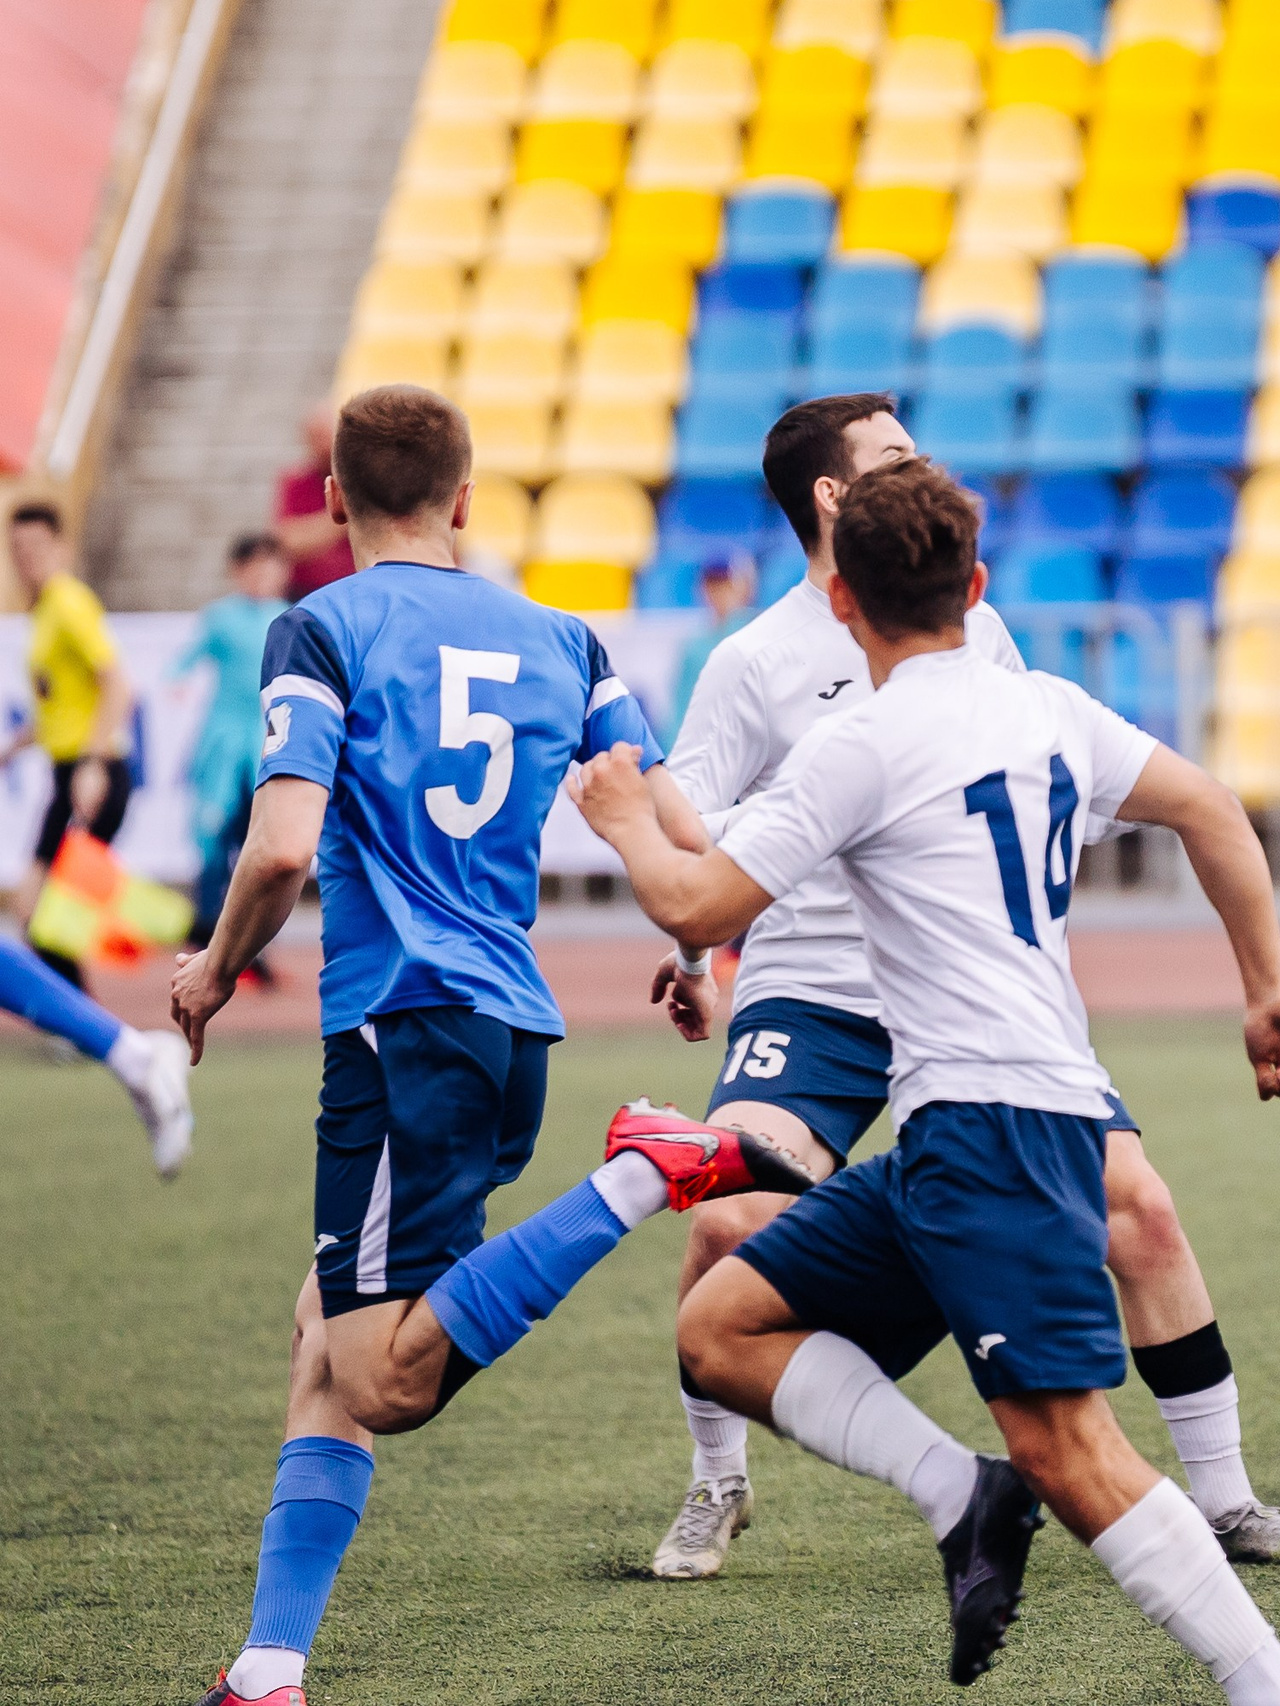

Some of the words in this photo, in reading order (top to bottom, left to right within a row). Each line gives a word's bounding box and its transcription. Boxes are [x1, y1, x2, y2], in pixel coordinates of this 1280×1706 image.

[425, 645, 520, 839] 5
[963, 752, 1079, 949] 14
[722, 1030, 792, 1085] 15
